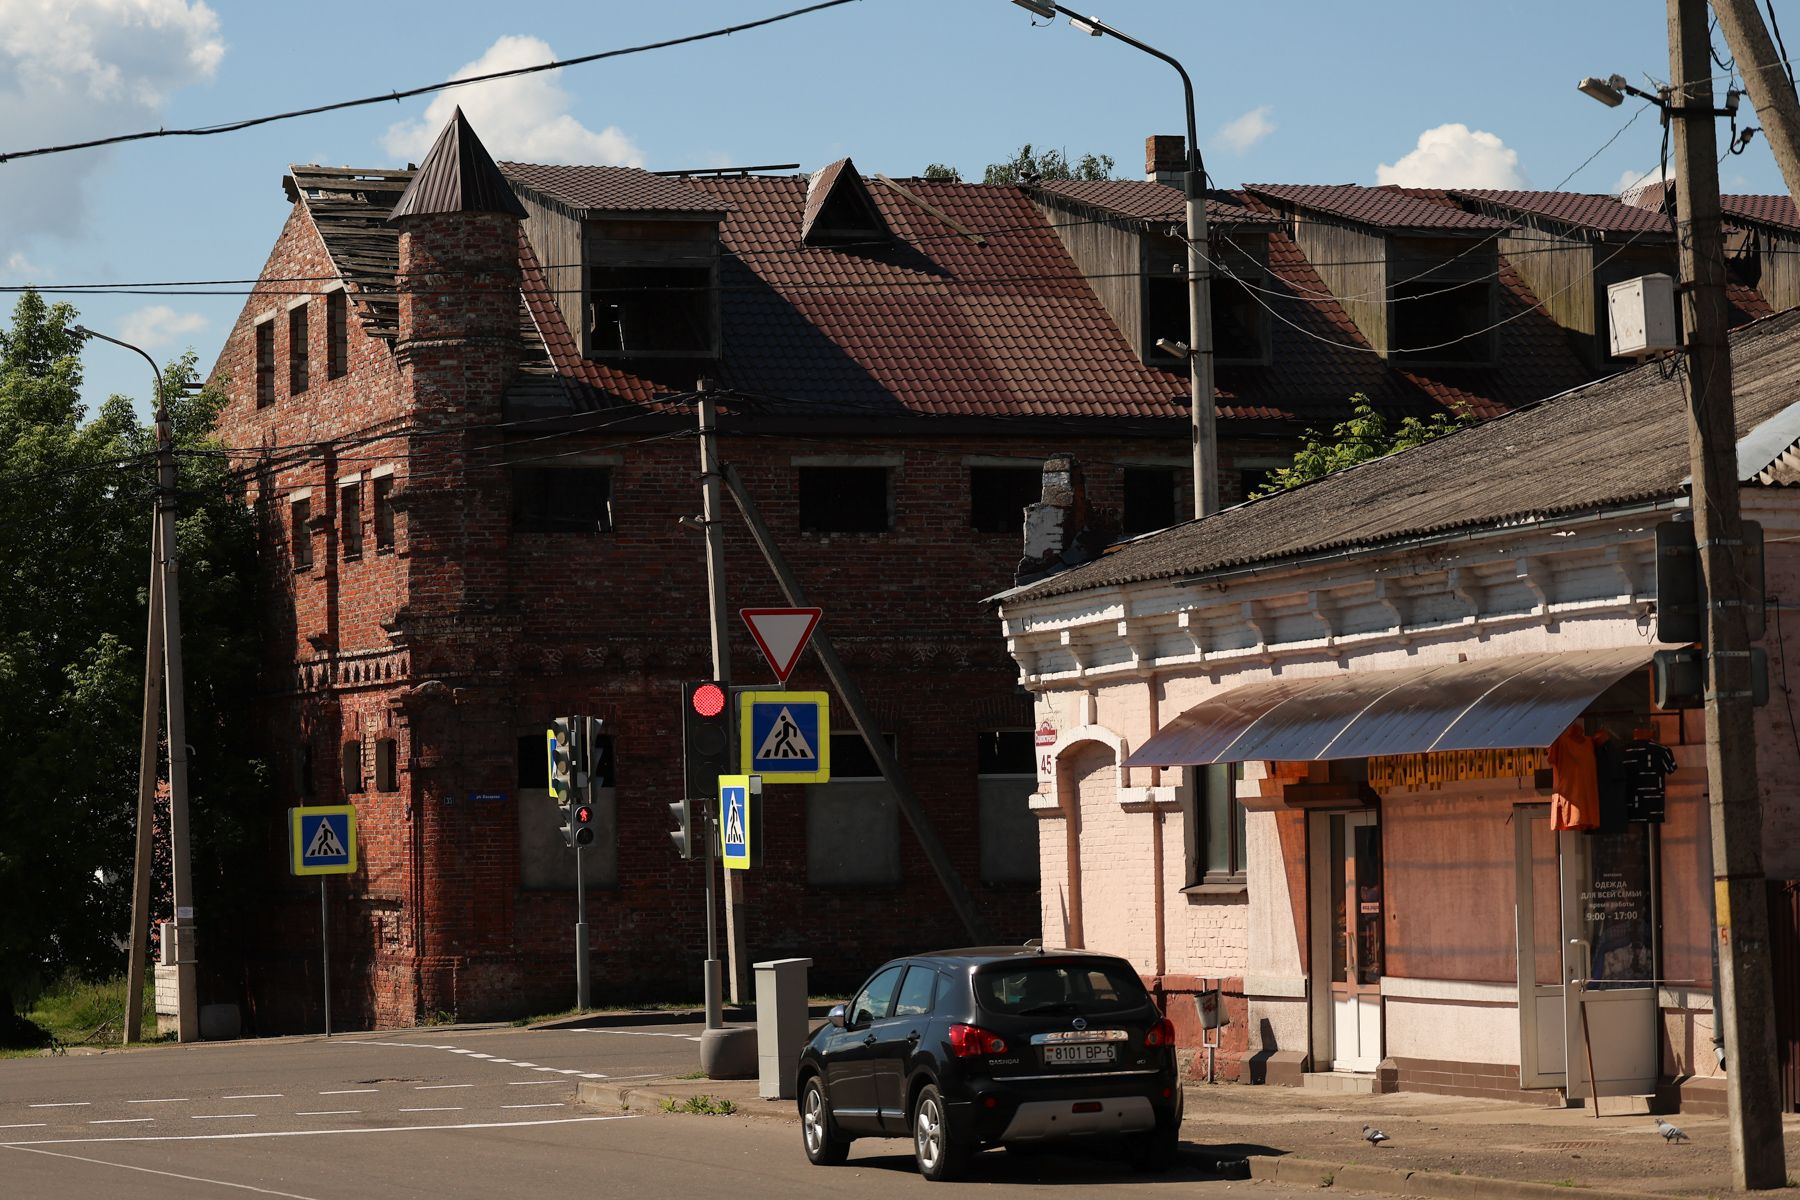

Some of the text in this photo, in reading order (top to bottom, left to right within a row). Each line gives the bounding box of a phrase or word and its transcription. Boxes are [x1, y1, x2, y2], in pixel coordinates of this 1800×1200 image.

[1041, 754, 1051, 775] 45
[1368, 754, 1425, 795] ОДЕЖДА
[1427, 751, 1457, 791] ДЛЯ
[1595, 881, 1627, 889] ОДЕЖДА
[1581, 889, 1642, 900] ДЛЯ ВСЕЙ СЕМЬИ
[1586, 912, 1605, 921] 9:00
[1614, 911, 1638, 920] 17:00
[1055, 1045, 1113, 1060] 8101 BP-6
